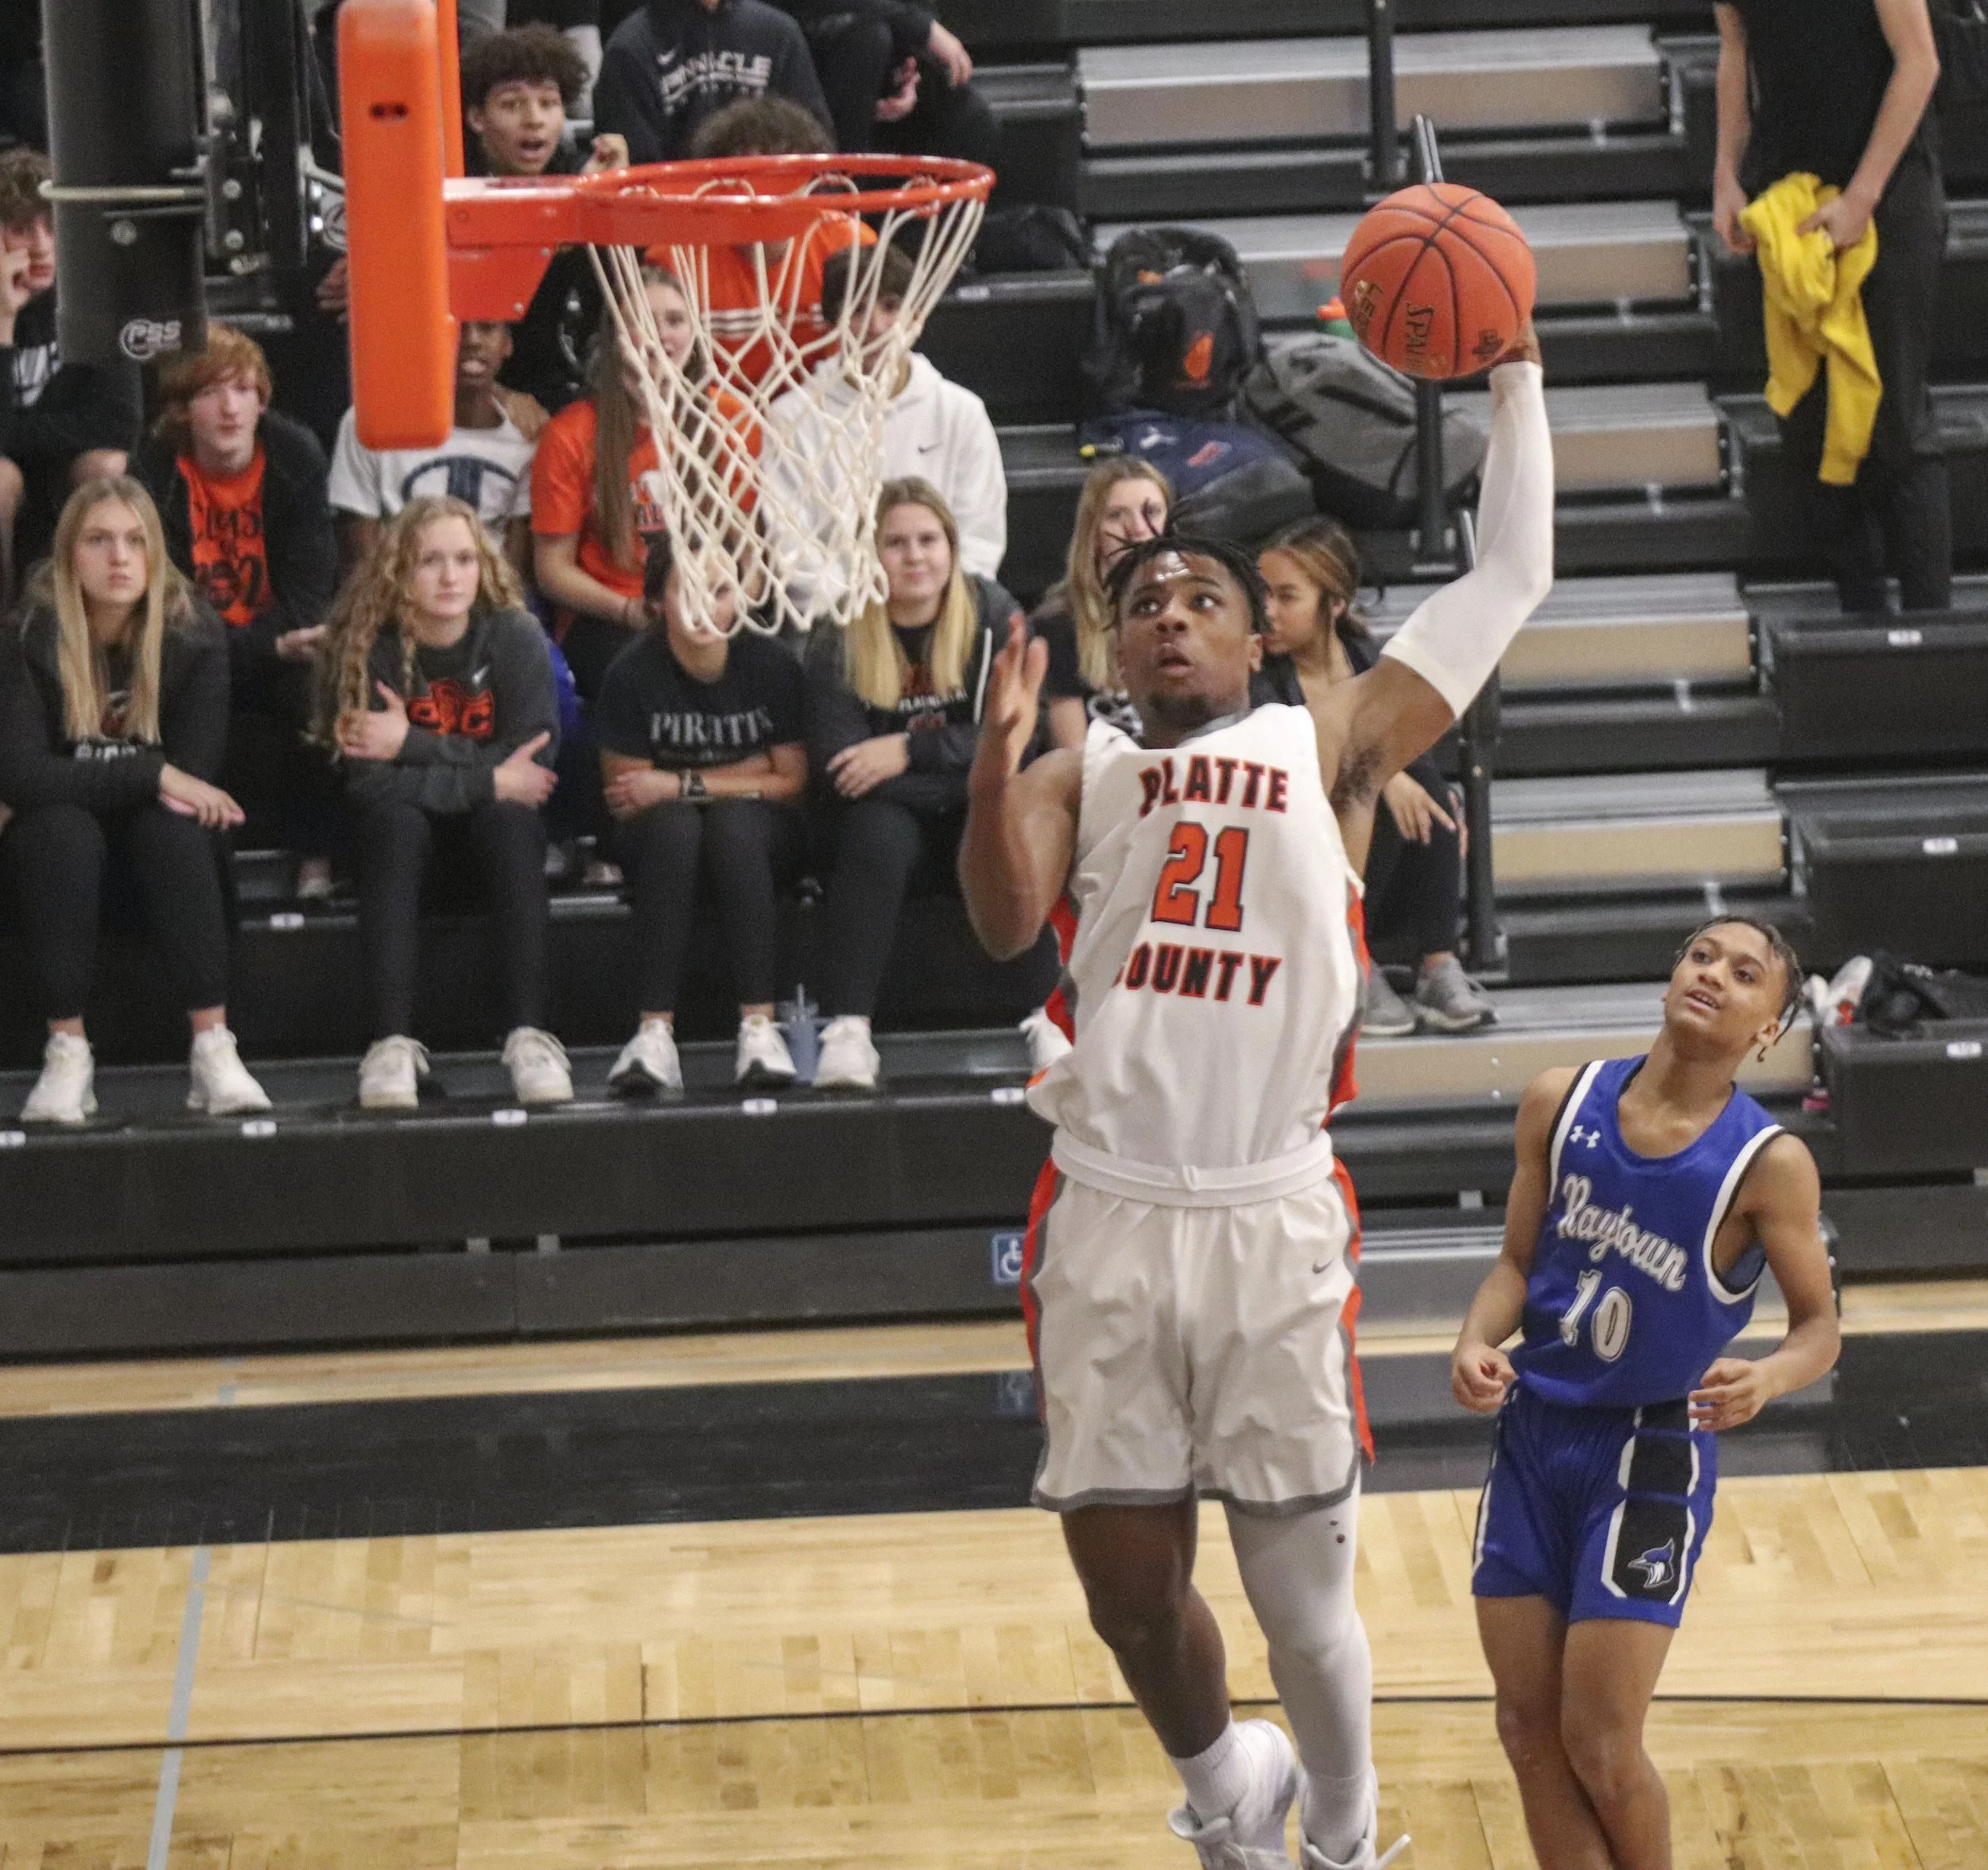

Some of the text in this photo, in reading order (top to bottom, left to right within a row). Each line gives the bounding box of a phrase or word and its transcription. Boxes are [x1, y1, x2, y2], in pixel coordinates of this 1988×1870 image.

[1138, 754, 1290, 818] PLATTE
[1150, 820, 1251, 932] 21
[1113, 941, 1283, 1005] OUNTY
[1556, 1172, 1688, 1292] Raytown
[1559, 1269, 1633, 1363] 10
